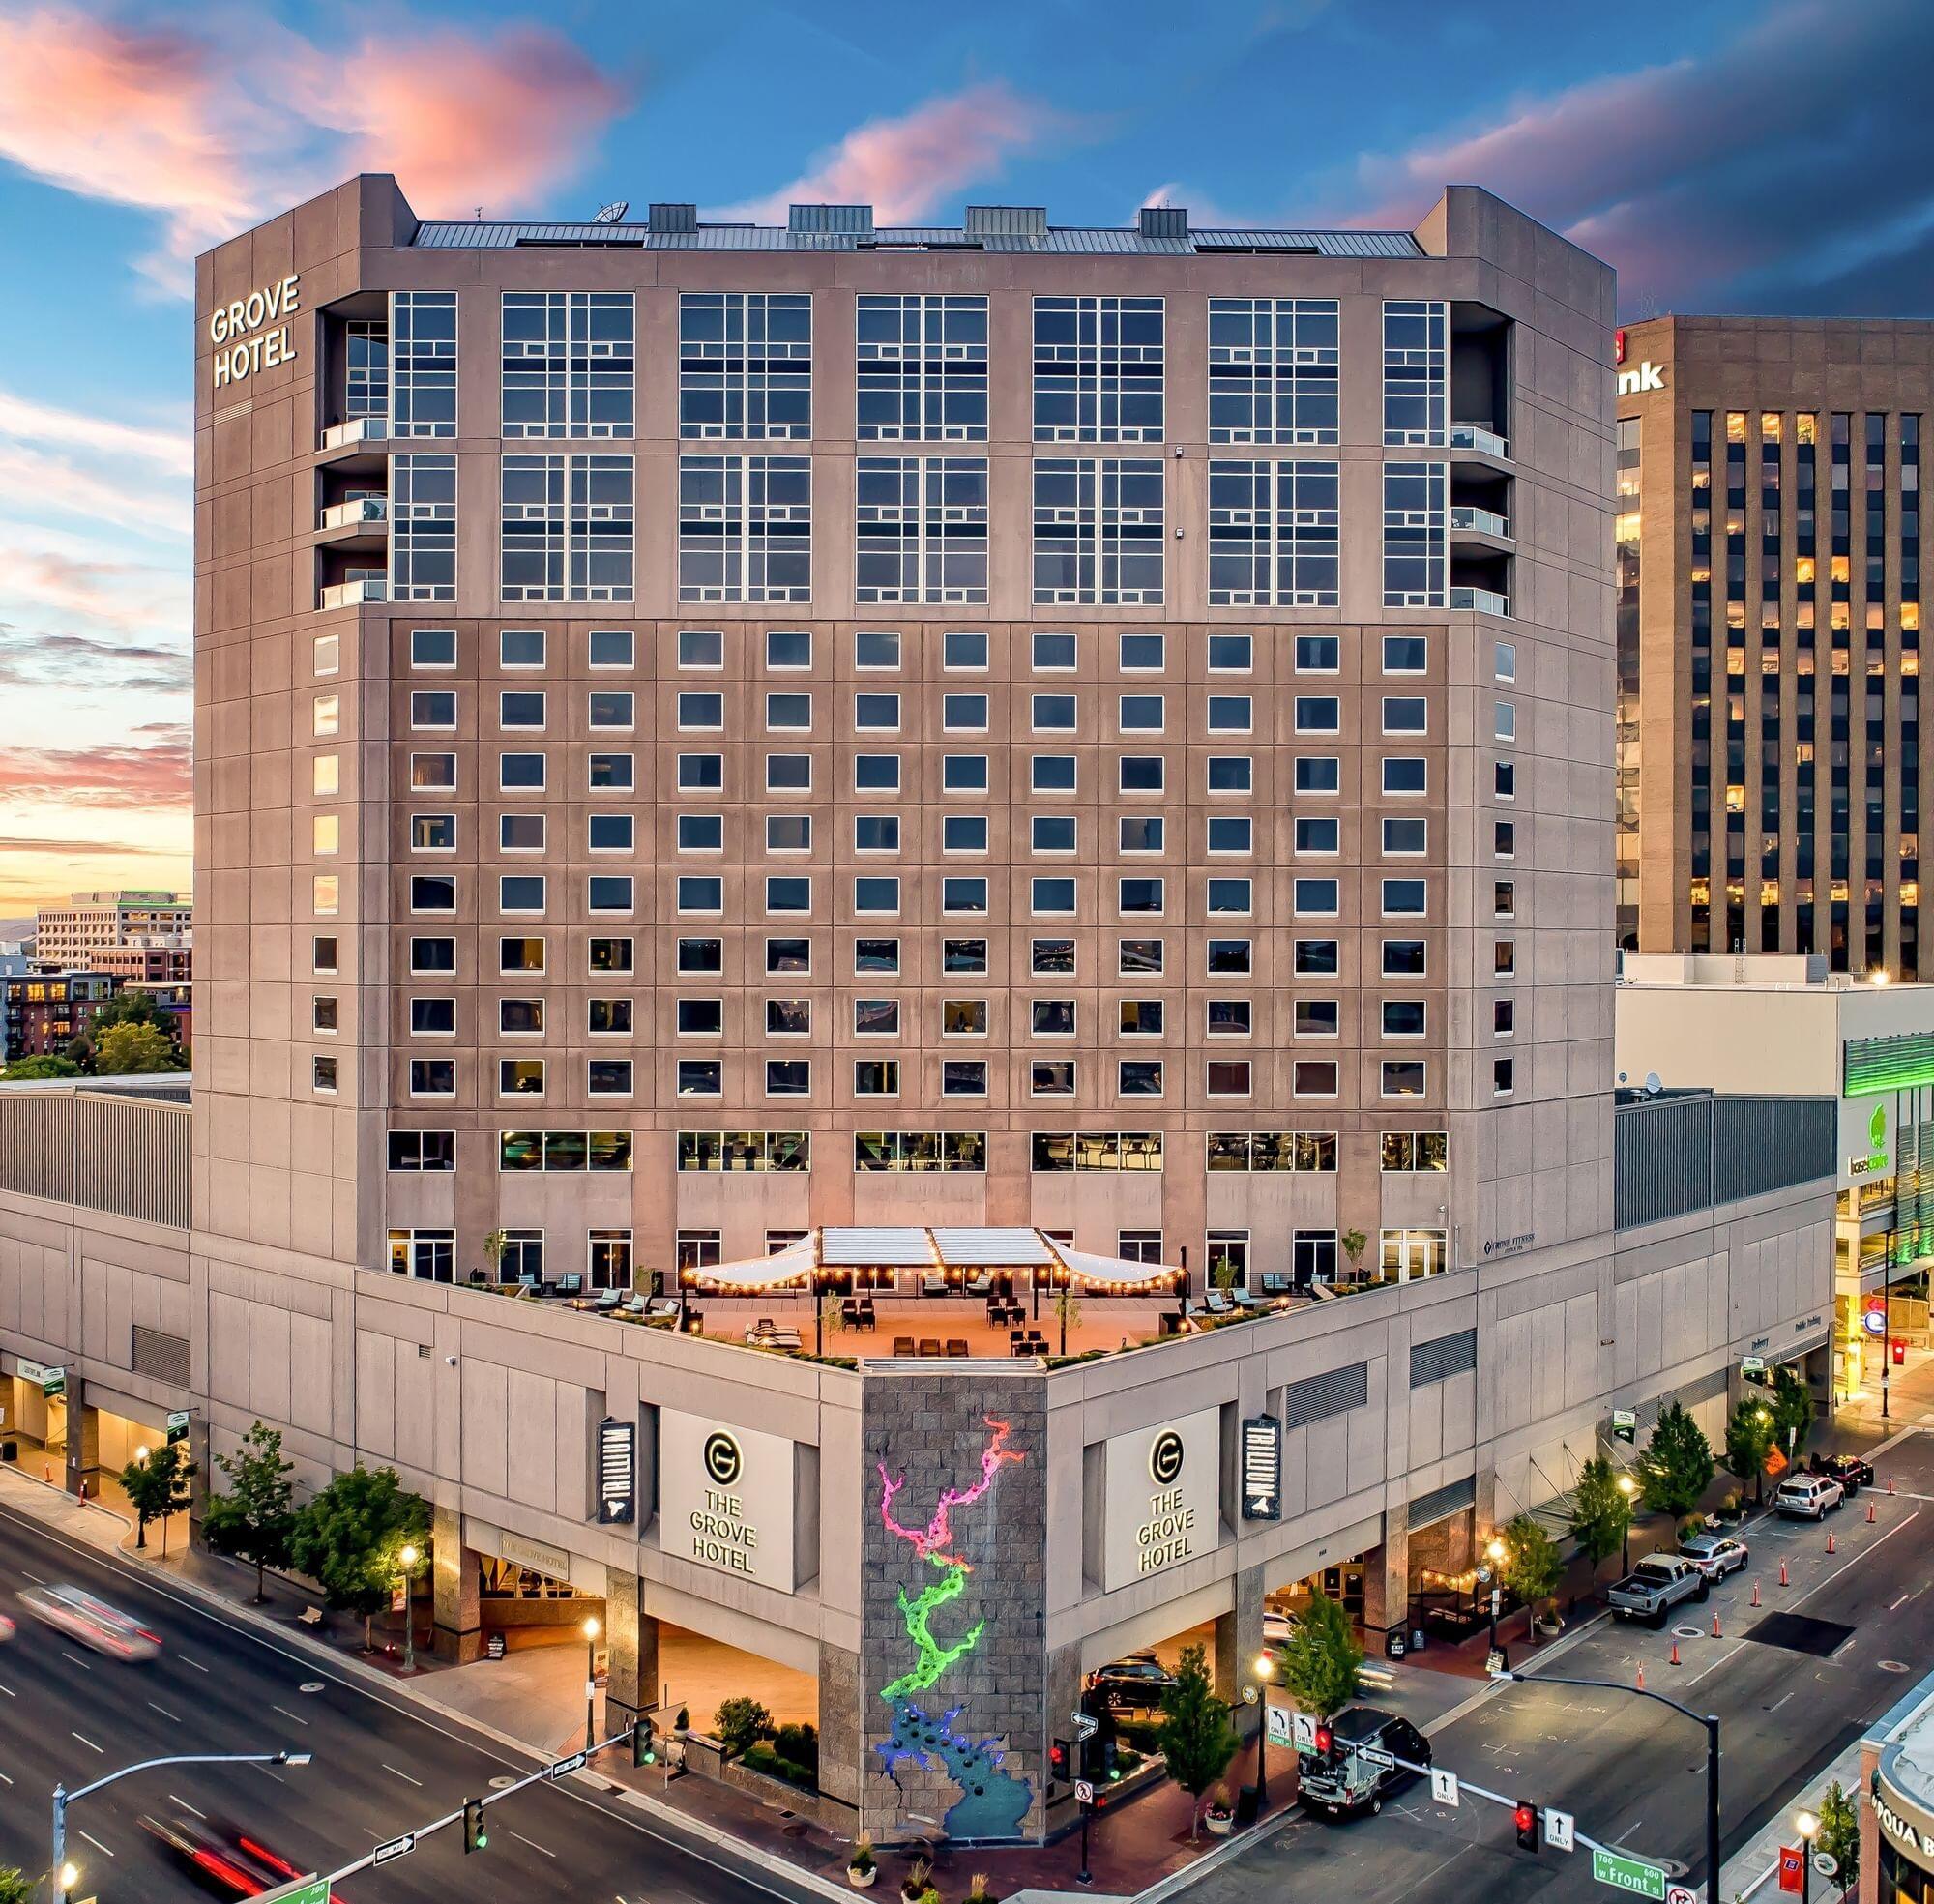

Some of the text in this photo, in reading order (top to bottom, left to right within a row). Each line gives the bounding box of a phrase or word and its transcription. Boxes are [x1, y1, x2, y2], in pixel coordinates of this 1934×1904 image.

[210, 274, 300, 344] GROVE
[215, 325, 297, 388] HOTEL
[1618, 360, 1665, 395] nk
[602, 1427, 631, 1501] TRILLIUM
[1245, 1426, 1275, 1497] TRILLIUM
[704, 1488, 743, 1518] THE
[1150, 1487, 1183, 1517] THE
[689, 1510, 758, 1549] GROVE
[1136, 1509, 1195, 1547] GROVE
[542, 1554, 567, 1571] HOTEL
[692, 1537, 757, 1575] HOTEL
[1138, 1537, 1193, 1573] HOTEL
[1270, 1726, 1287, 1737] ONLY
[1297, 1734, 1314, 1744] ONLY
[1436, 1790, 1455, 1802] ONLY
[1549, 1833, 1569, 1846] ONLY
[1598, 1854, 1613, 1865] 700
[1644, 1868, 1659, 1880] 600
[309, 1883, 326, 1896] 200
[1609, 1867, 1648, 1892] Front
[1652, 1886, 1659, 1895] St
